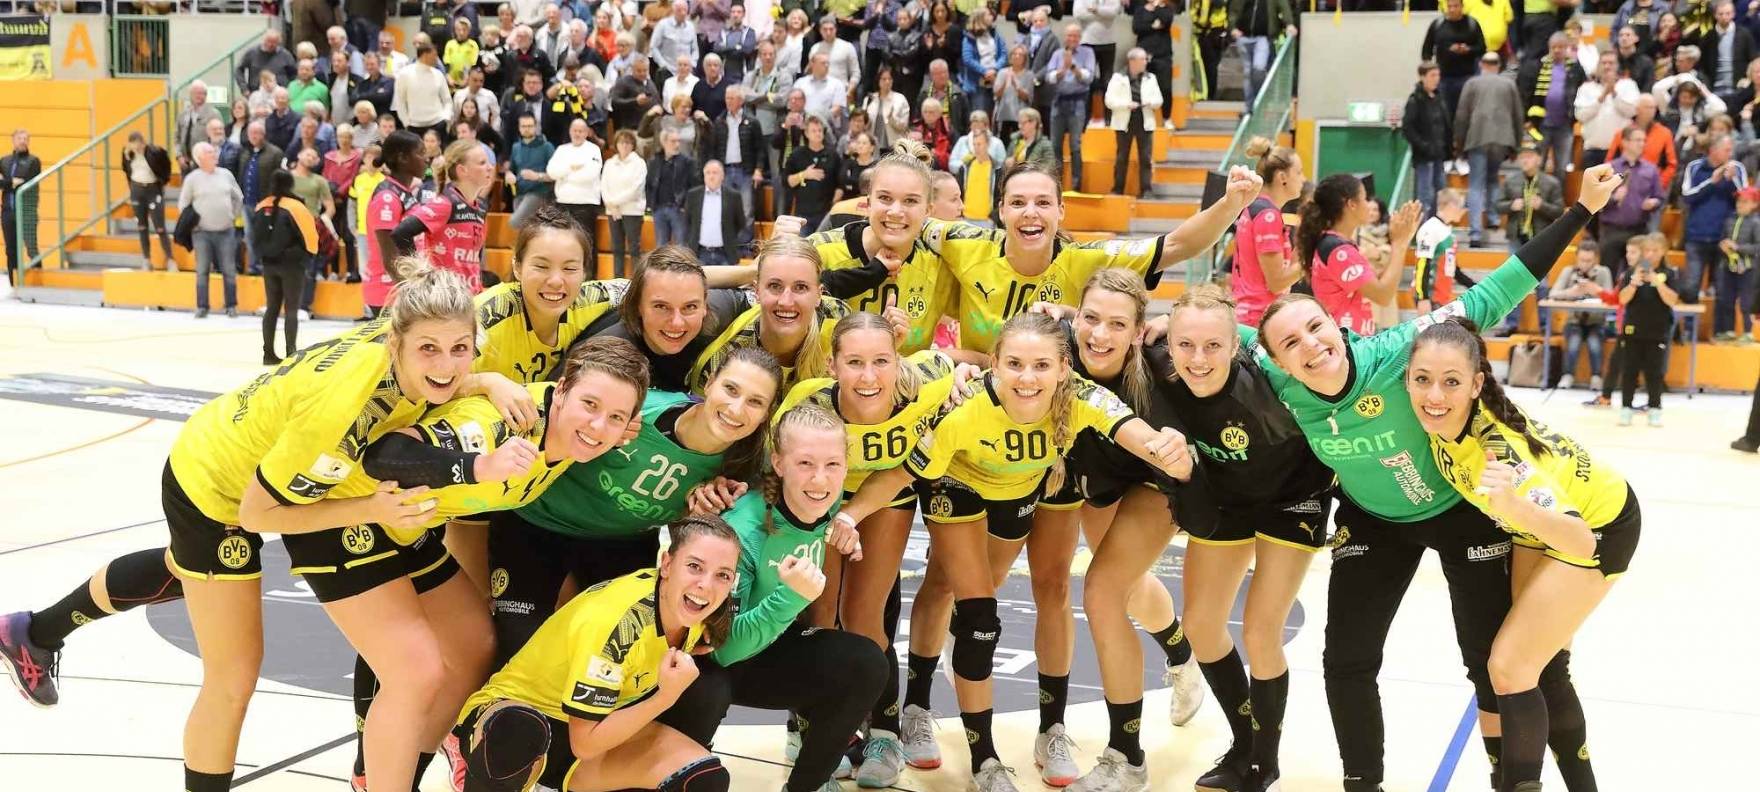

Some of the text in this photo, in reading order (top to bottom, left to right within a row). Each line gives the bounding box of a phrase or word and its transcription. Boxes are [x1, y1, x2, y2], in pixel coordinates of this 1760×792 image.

[63, 20, 97, 68] A
[1040, 285, 1060, 301] BVB
[908, 297, 924, 312] BVB
[1358, 397, 1381, 413] BVB
[862, 426, 907, 461] 66
[1005, 429, 1047, 462] 90
[1225, 430, 1245, 444] BVB
[632, 454, 688, 500] 26
[932, 499, 950, 514] BVB
[346, 527, 372, 548] BVB
[223, 539, 248, 559] BVB
